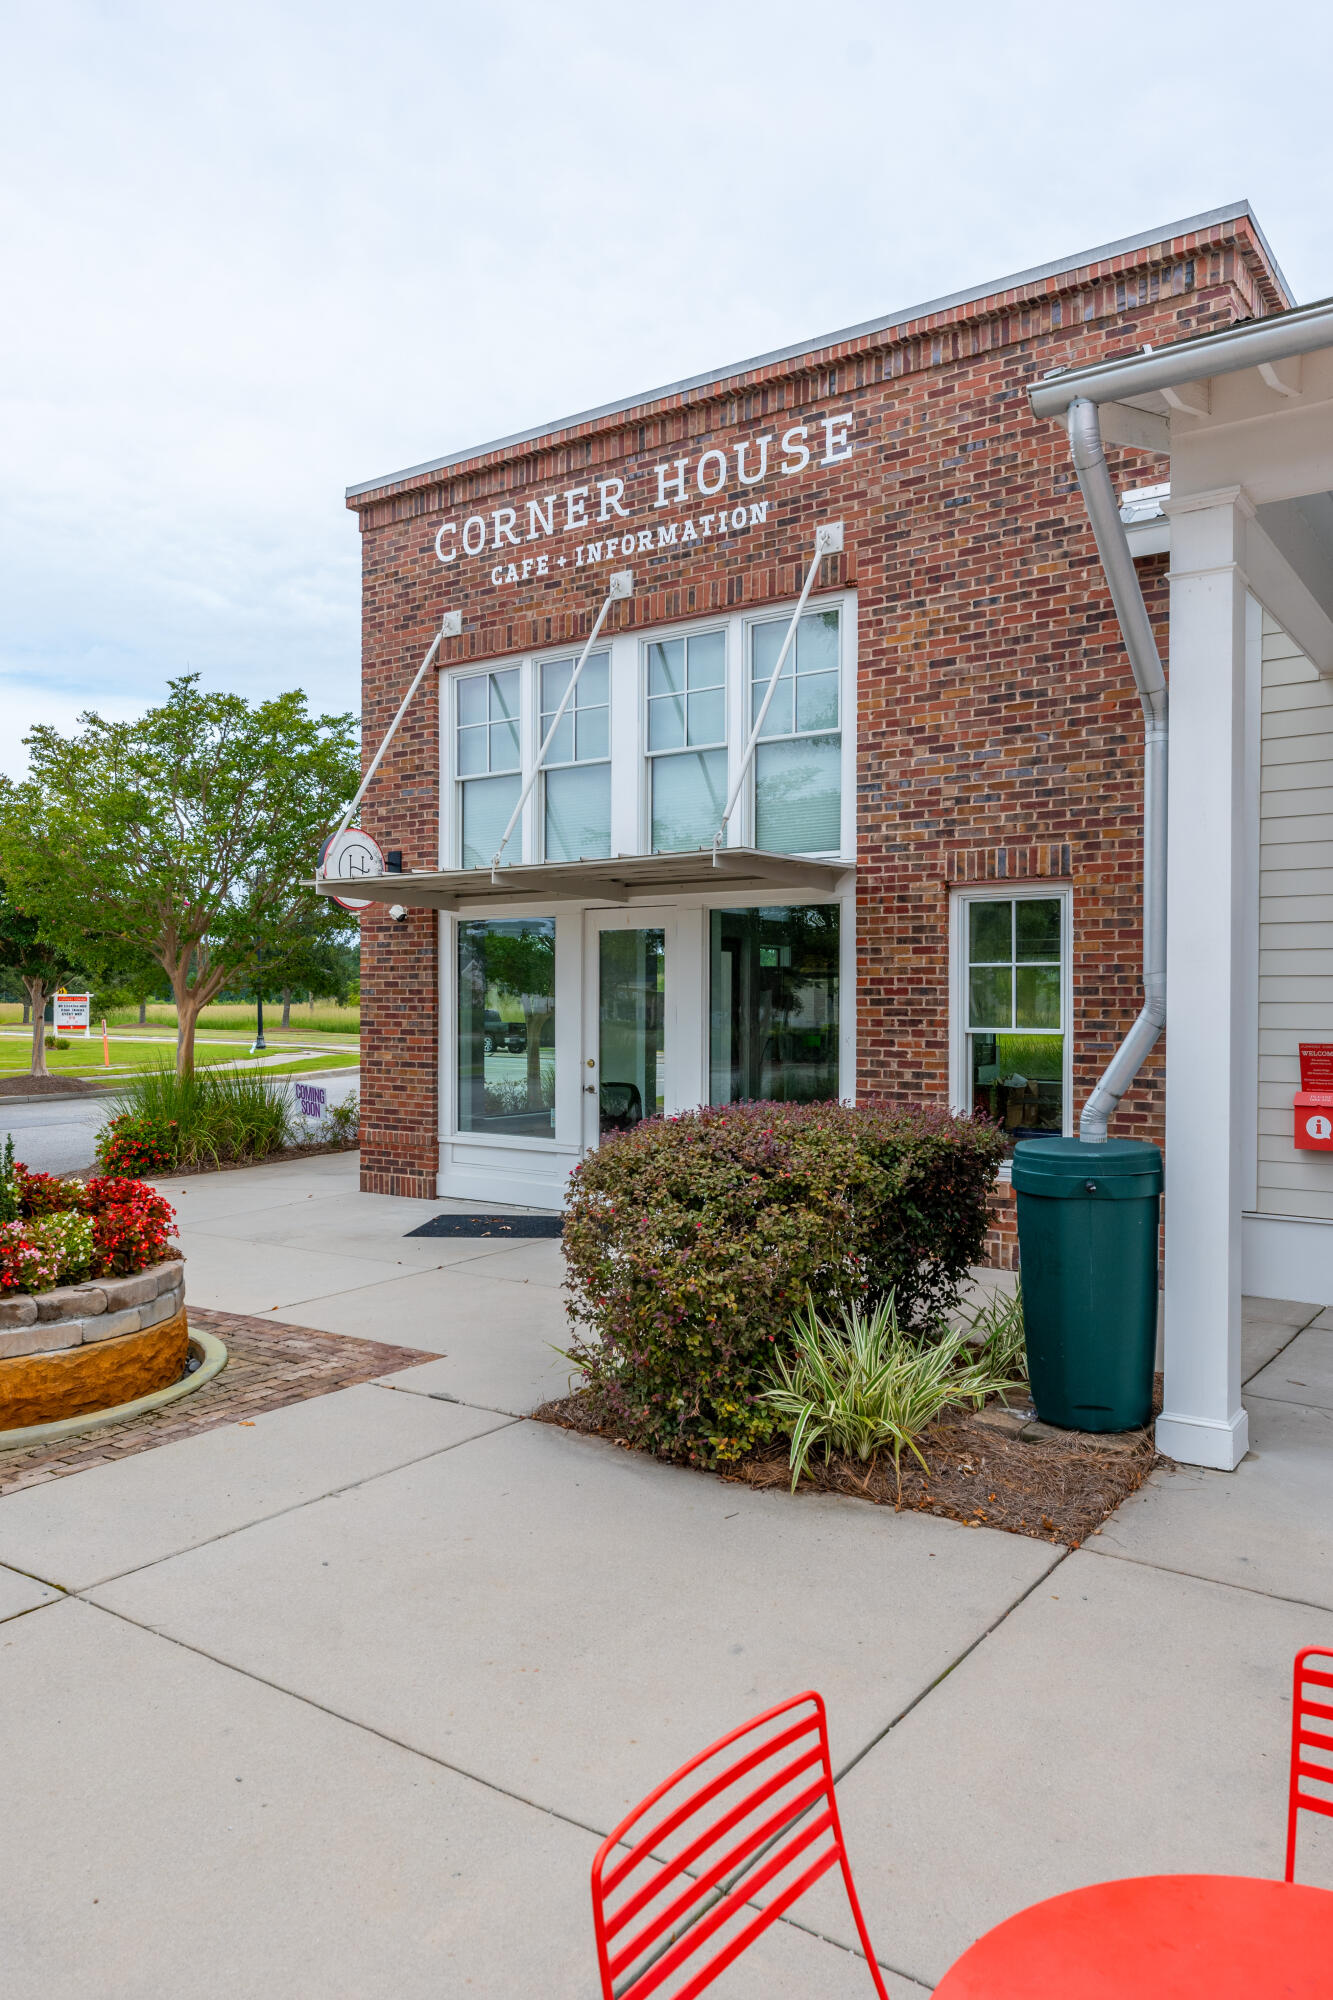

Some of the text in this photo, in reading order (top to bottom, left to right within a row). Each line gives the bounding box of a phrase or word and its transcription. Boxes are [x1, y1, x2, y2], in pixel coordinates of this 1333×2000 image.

[434, 412, 854, 563] CORNER HOUSE
[490, 553, 550, 586] CAFE
[574, 500, 770, 567] INFORMATION
[295, 1083, 325, 1104] COMING
[301, 1099, 321, 1118] SOON
